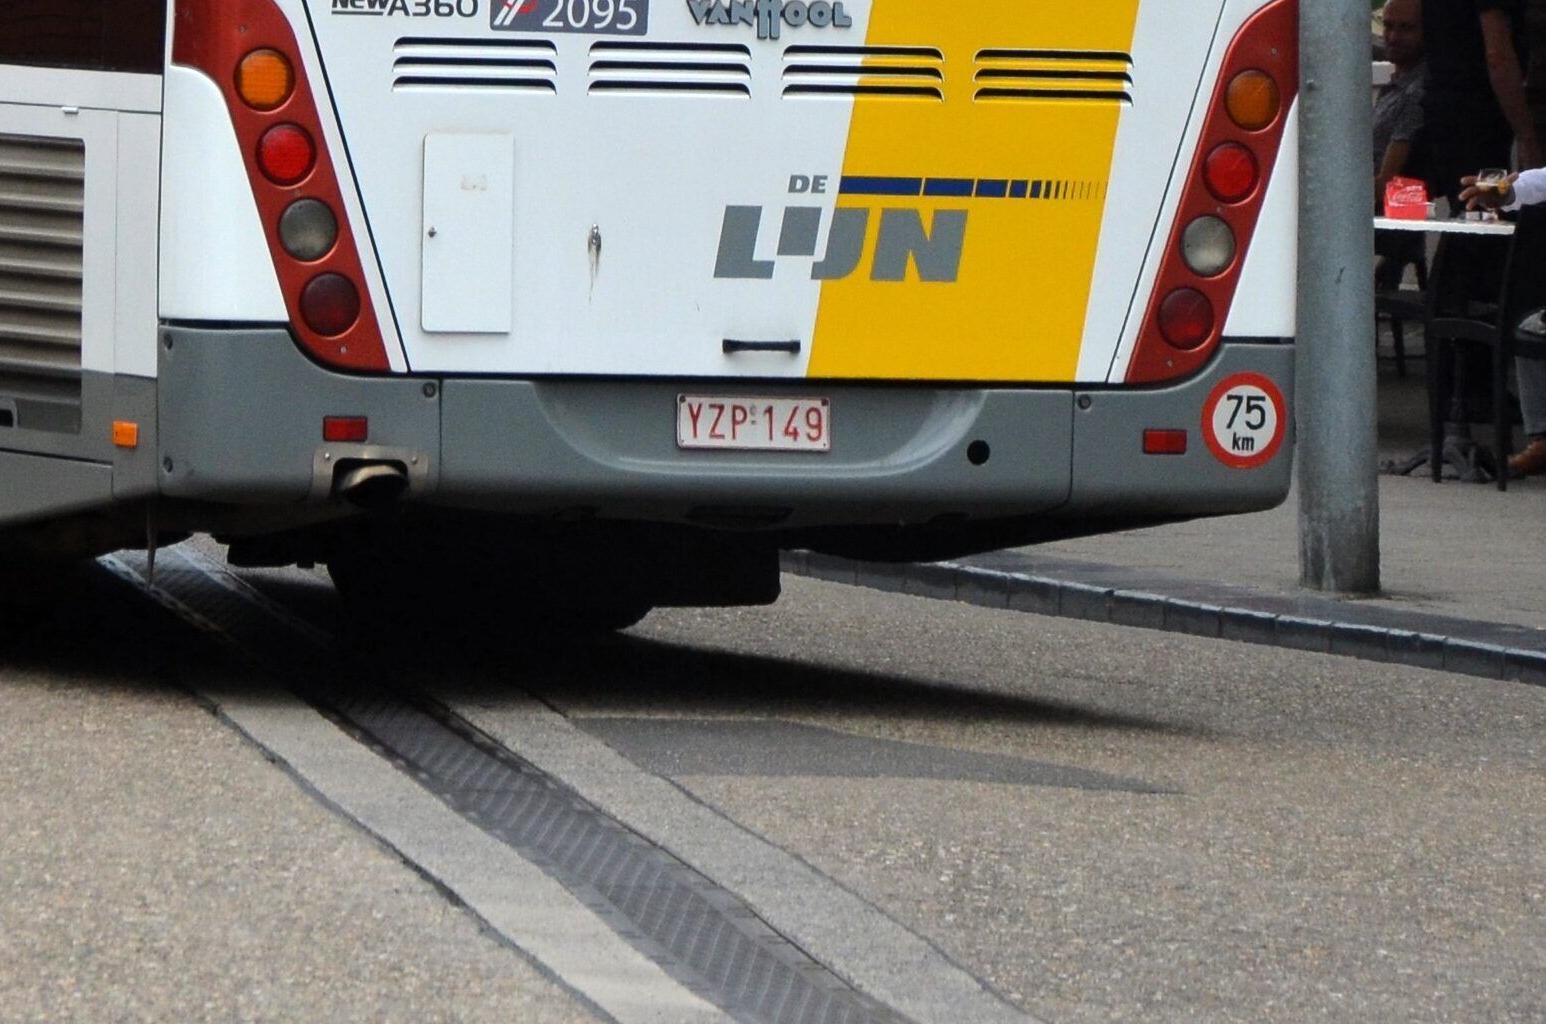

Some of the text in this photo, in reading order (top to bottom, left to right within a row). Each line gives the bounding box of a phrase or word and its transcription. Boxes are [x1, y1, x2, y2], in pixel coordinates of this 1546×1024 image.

[787, 174, 829, 194] DE
[713, 204, 969, 282] LIJN
[1226, 394, 1266, 430] 75
[1232, 432, 1255, 451] km
